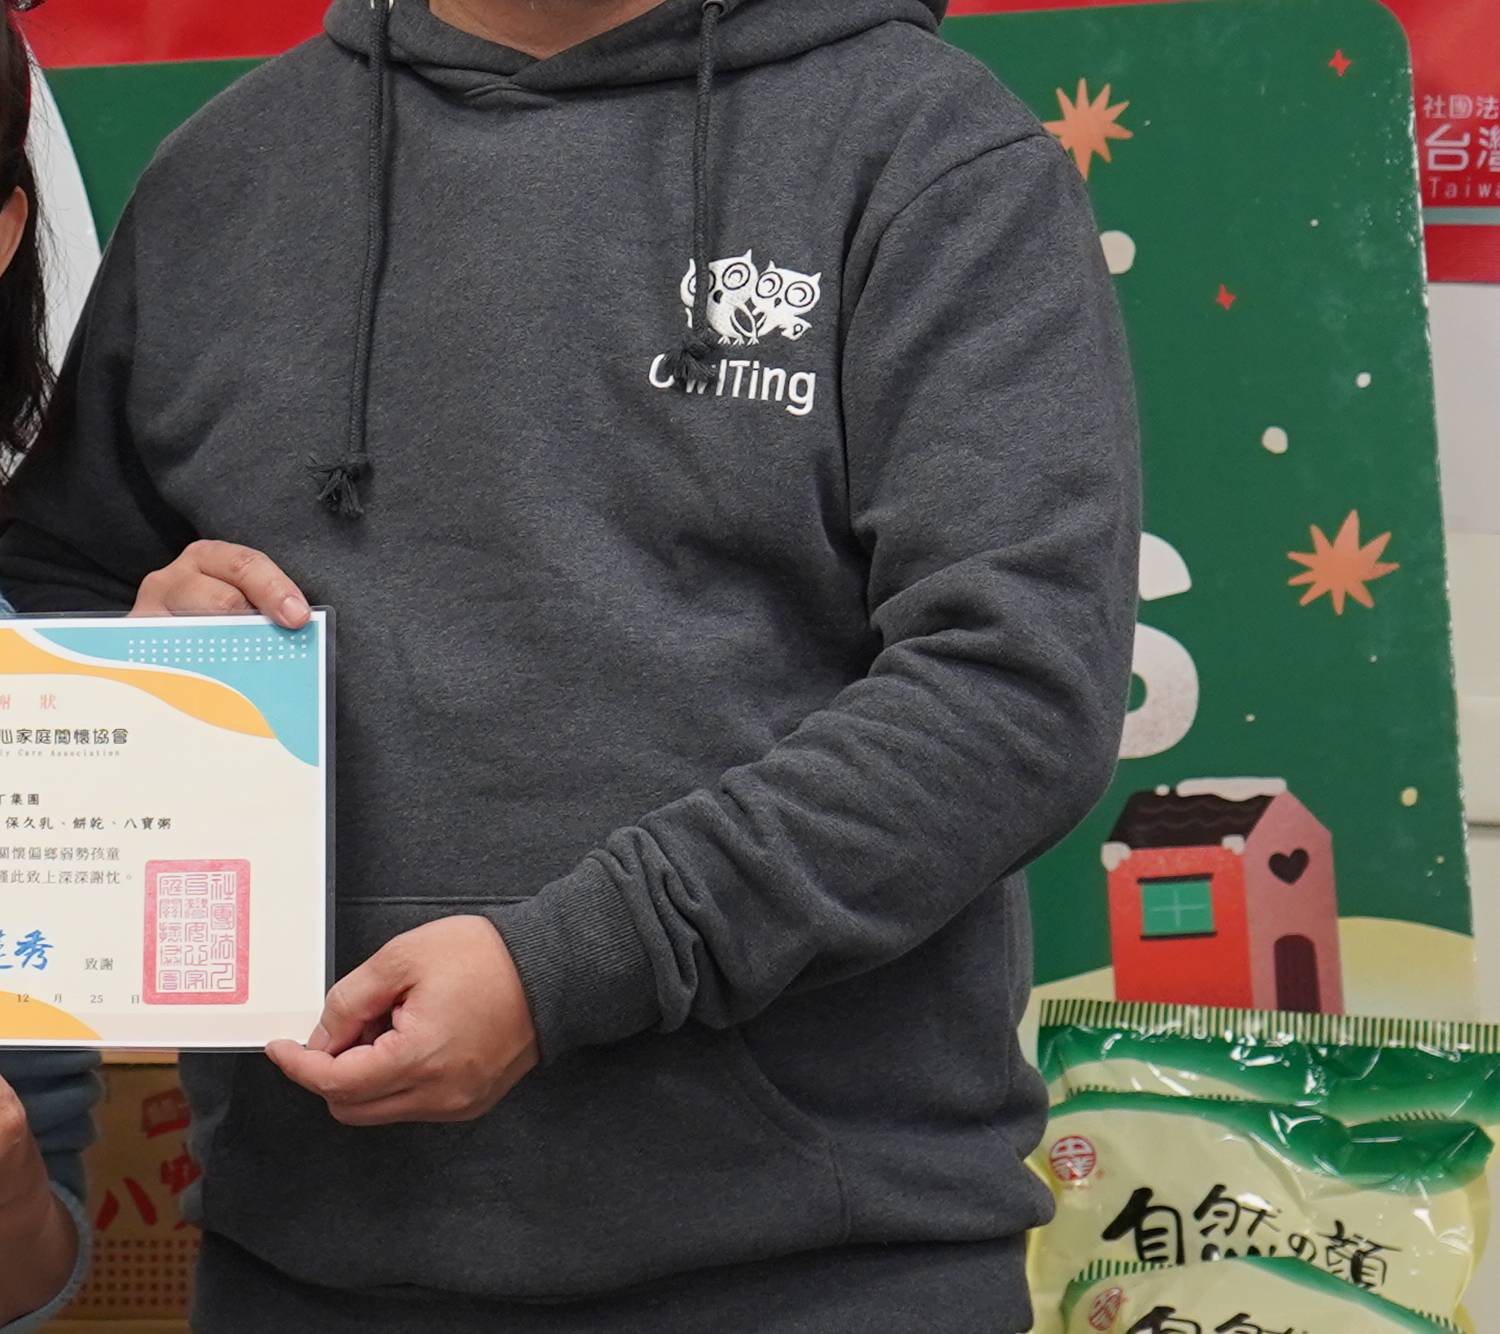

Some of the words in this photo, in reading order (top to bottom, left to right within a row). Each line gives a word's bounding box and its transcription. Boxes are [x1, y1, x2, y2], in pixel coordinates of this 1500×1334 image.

[83, 956, 114, 972] 致謝
[16, 993, 30, 1004] 12
[53, 993, 64, 1005] 月
[89, 993, 104, 1005] 25
